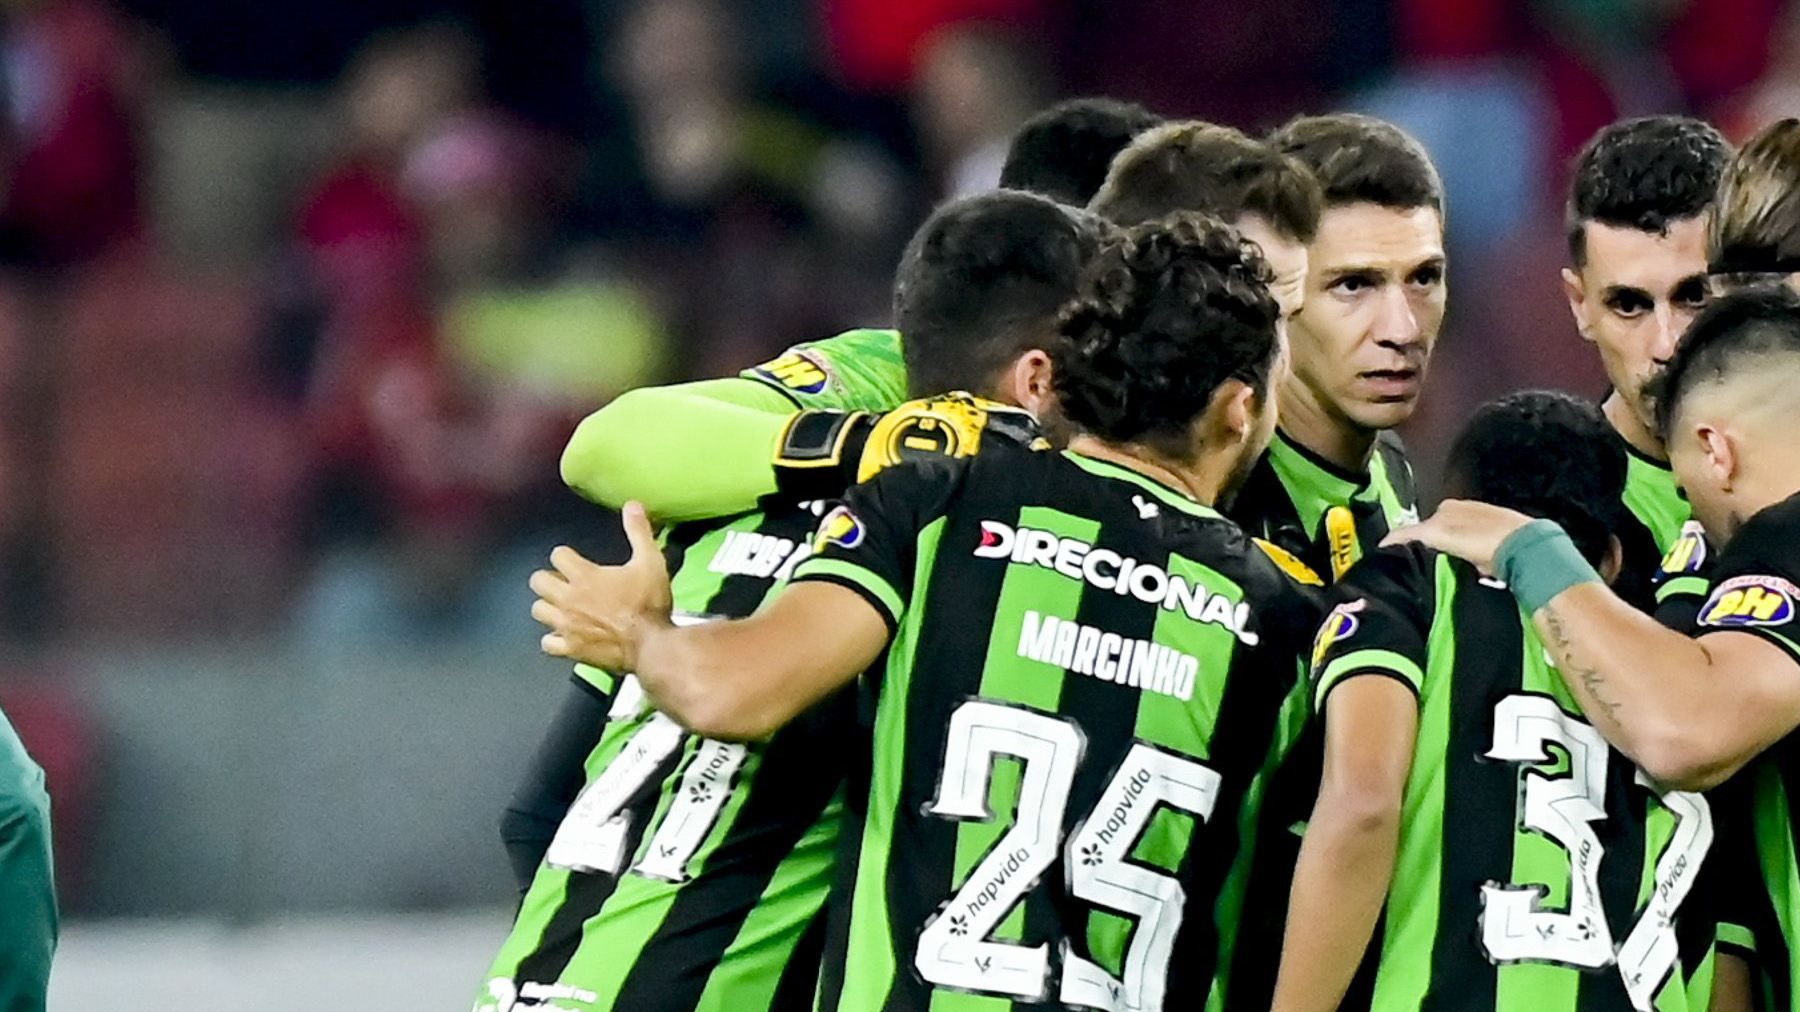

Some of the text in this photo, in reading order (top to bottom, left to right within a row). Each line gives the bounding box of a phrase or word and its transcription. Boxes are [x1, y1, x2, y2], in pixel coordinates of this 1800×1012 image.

[974, 520, 1259, 646] DIRECIONAL
[1706, 586, 1784, 621] BH
[1017, 609, 1198, 701] MARCINHO
[1096, 766, 1152, 846] hapvida
[965, 844, 1030, 920] hapvida
